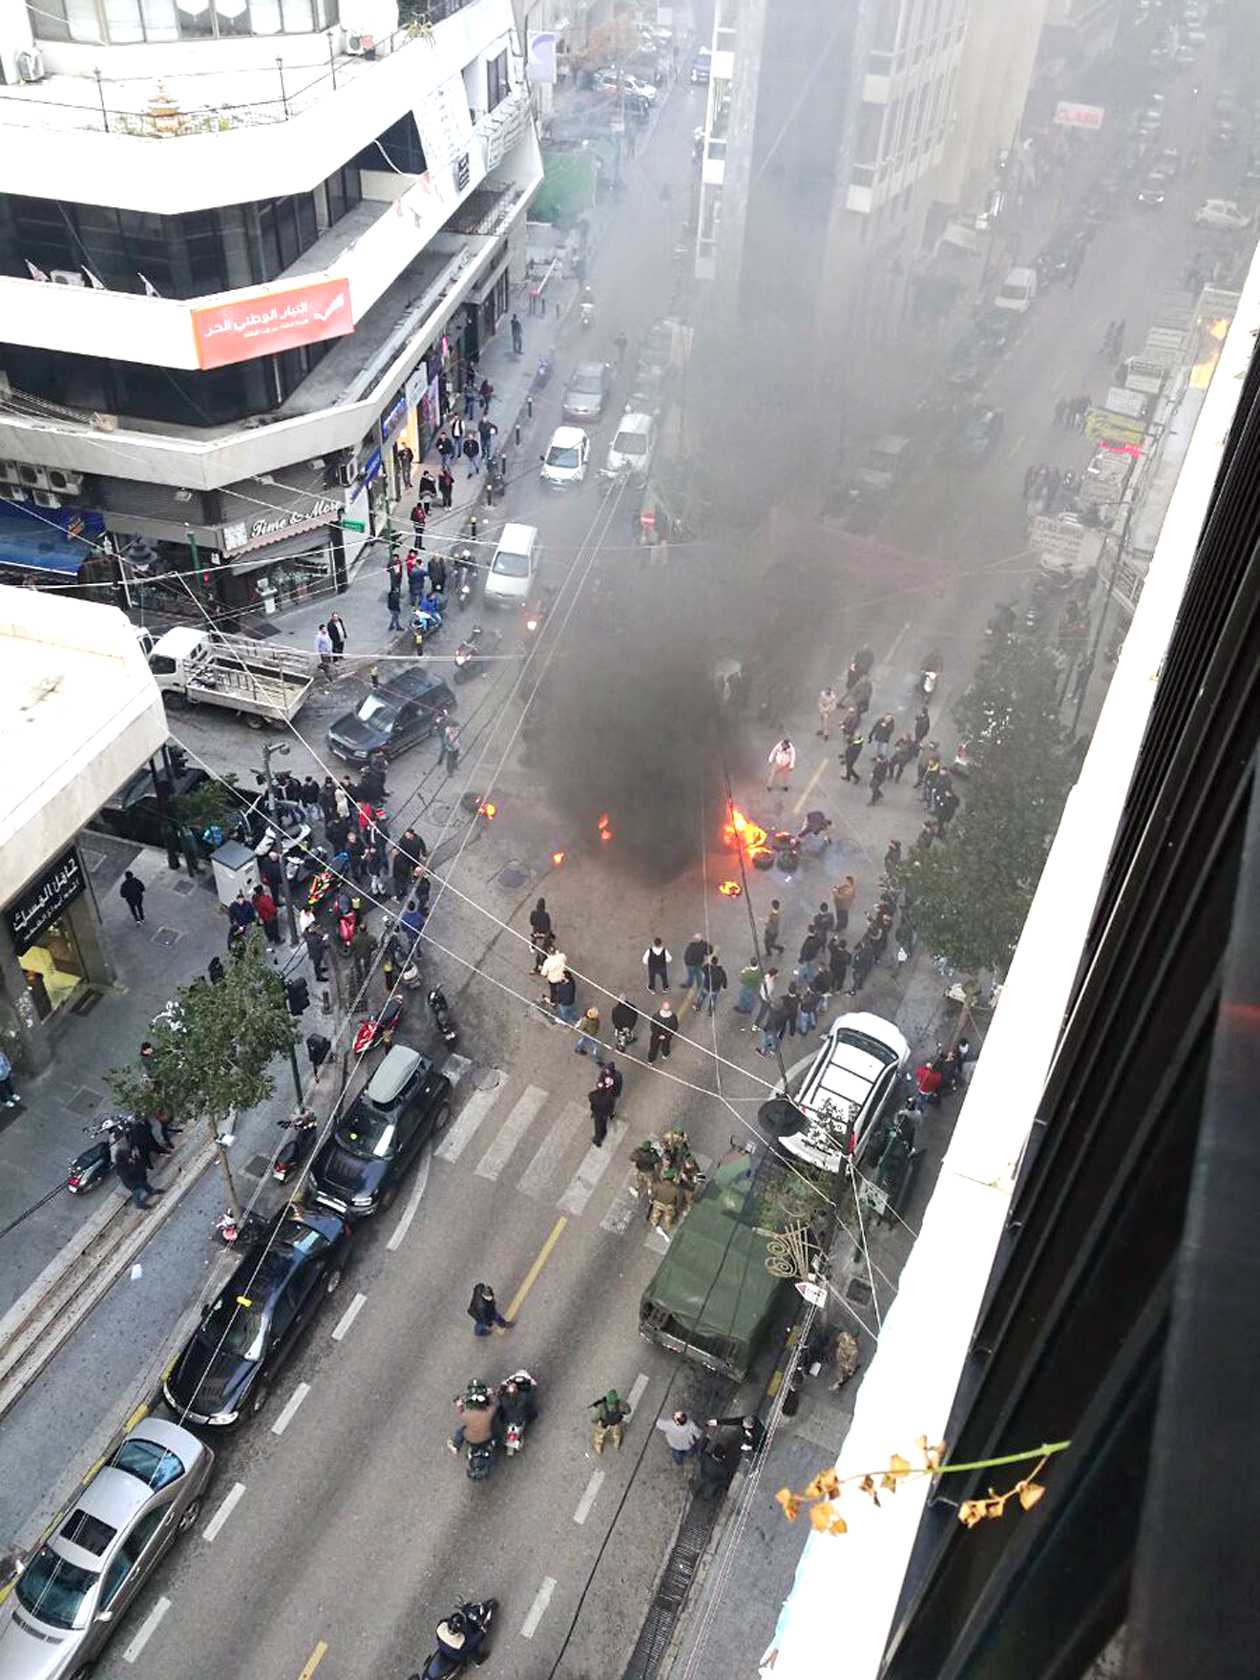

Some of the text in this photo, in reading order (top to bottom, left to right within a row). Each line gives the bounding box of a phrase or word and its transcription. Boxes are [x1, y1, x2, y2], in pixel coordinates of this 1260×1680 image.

[233, 308, 278, 331] الوطني
[280, 302, 308, 320] التيار
[204, 319, 232, 338] الحر
[251, 518, 290, 538] Time
[303, 500, 342, 521] More
